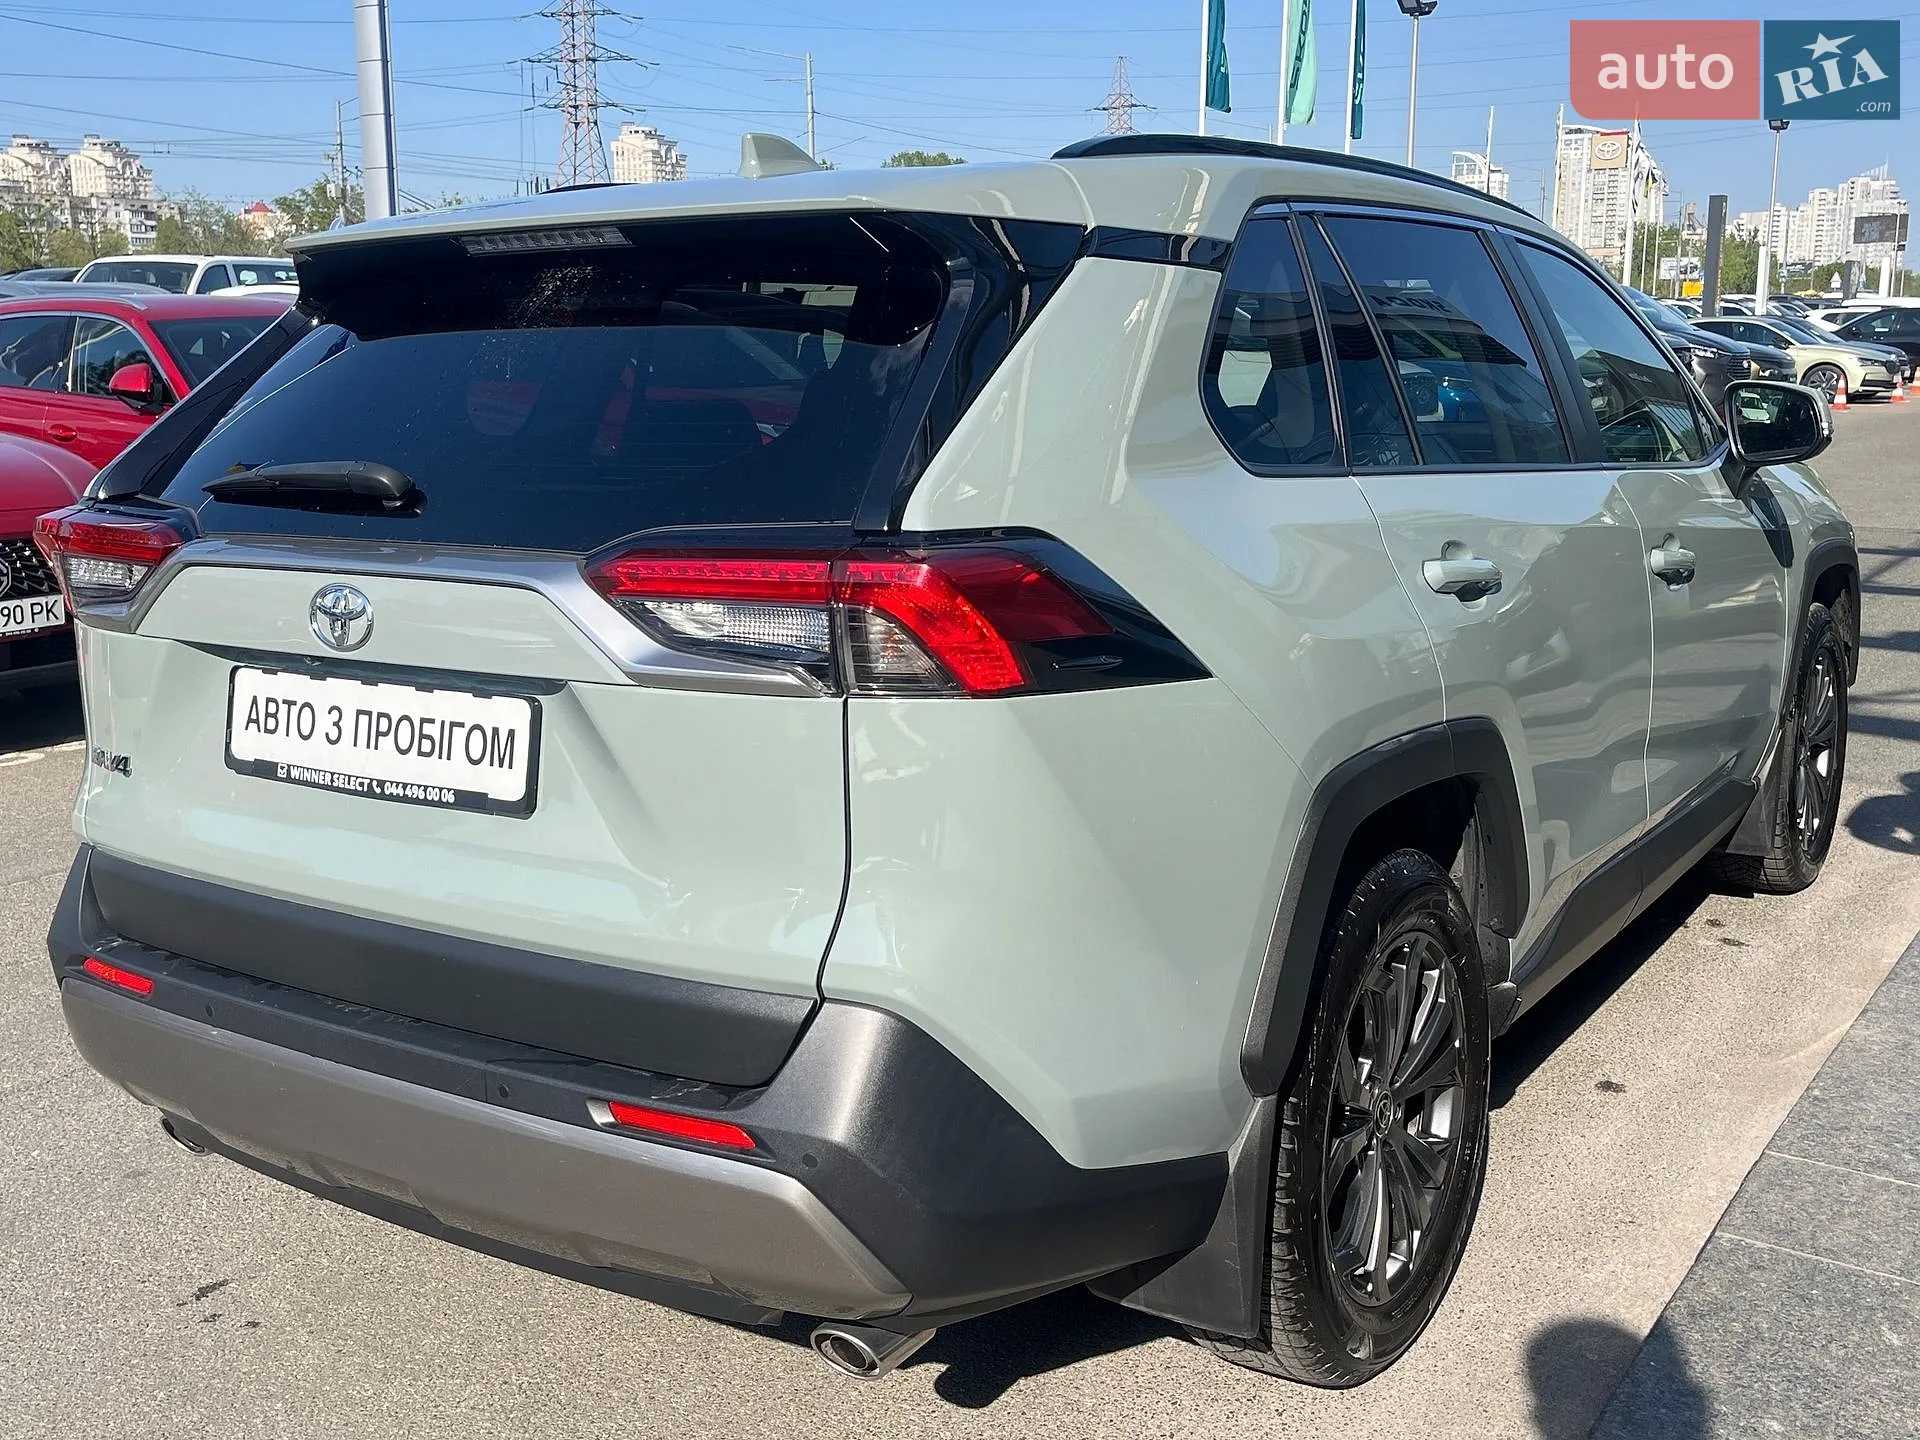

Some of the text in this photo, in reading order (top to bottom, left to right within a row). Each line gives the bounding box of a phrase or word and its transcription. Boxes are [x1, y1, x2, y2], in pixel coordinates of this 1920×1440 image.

[30, 599, 59, 623] PK
[245, 694, 316, 741] АВТО
[353, 708, 516, 770] ПРОБІГОМ
[290, 765, 332, 786] WINNER
[332, 775, 370, 792] SELECT
[384, 781, 404, 797] 044
[426, 787, 440, 801] 00
[440, 789, 455, 803] 06
